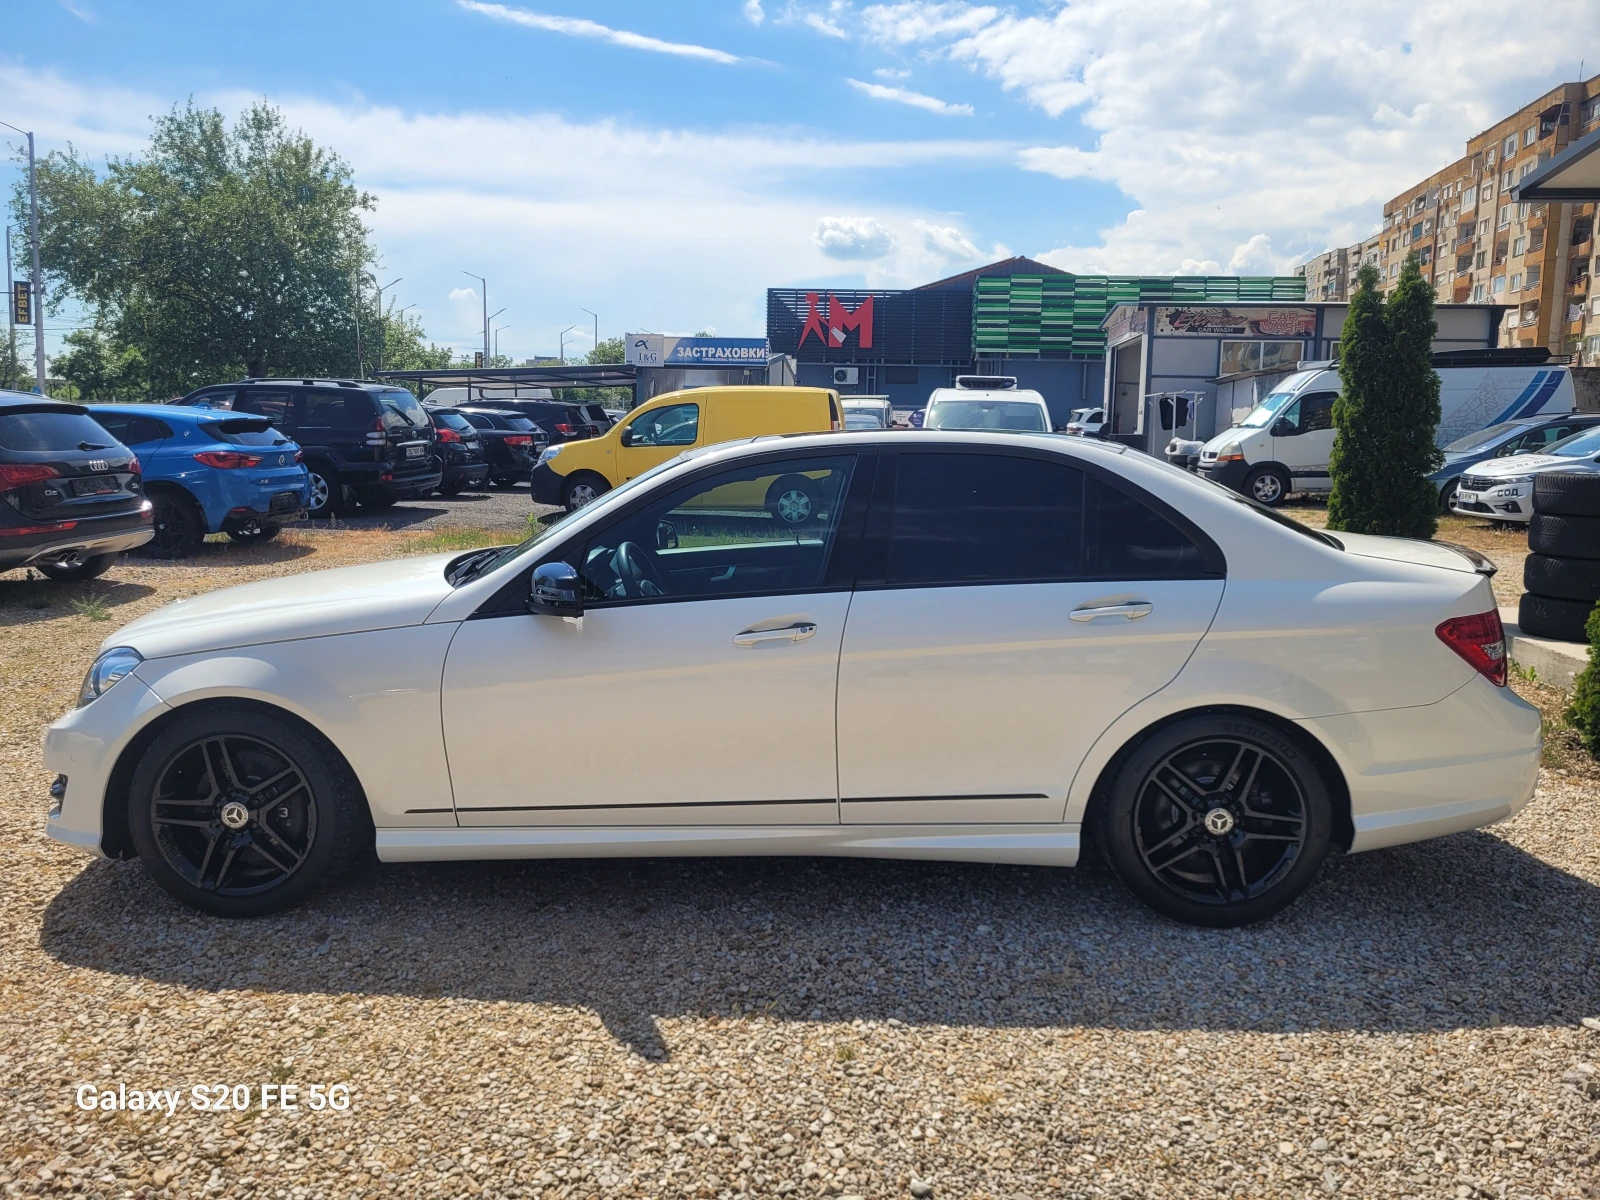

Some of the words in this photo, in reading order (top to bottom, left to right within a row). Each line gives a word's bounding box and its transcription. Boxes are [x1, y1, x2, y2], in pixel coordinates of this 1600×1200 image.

[18, 284, 28, 322] EFBET
[1267, 311, 1299, 322] CAR
[1260, 322, 1305, 333] WASH
[638, 352, 657, 361] I&G
[677, 347, 765, 358] ЗАСТРАХОВКИ
[1497, 488, 1519, 497] СОД
